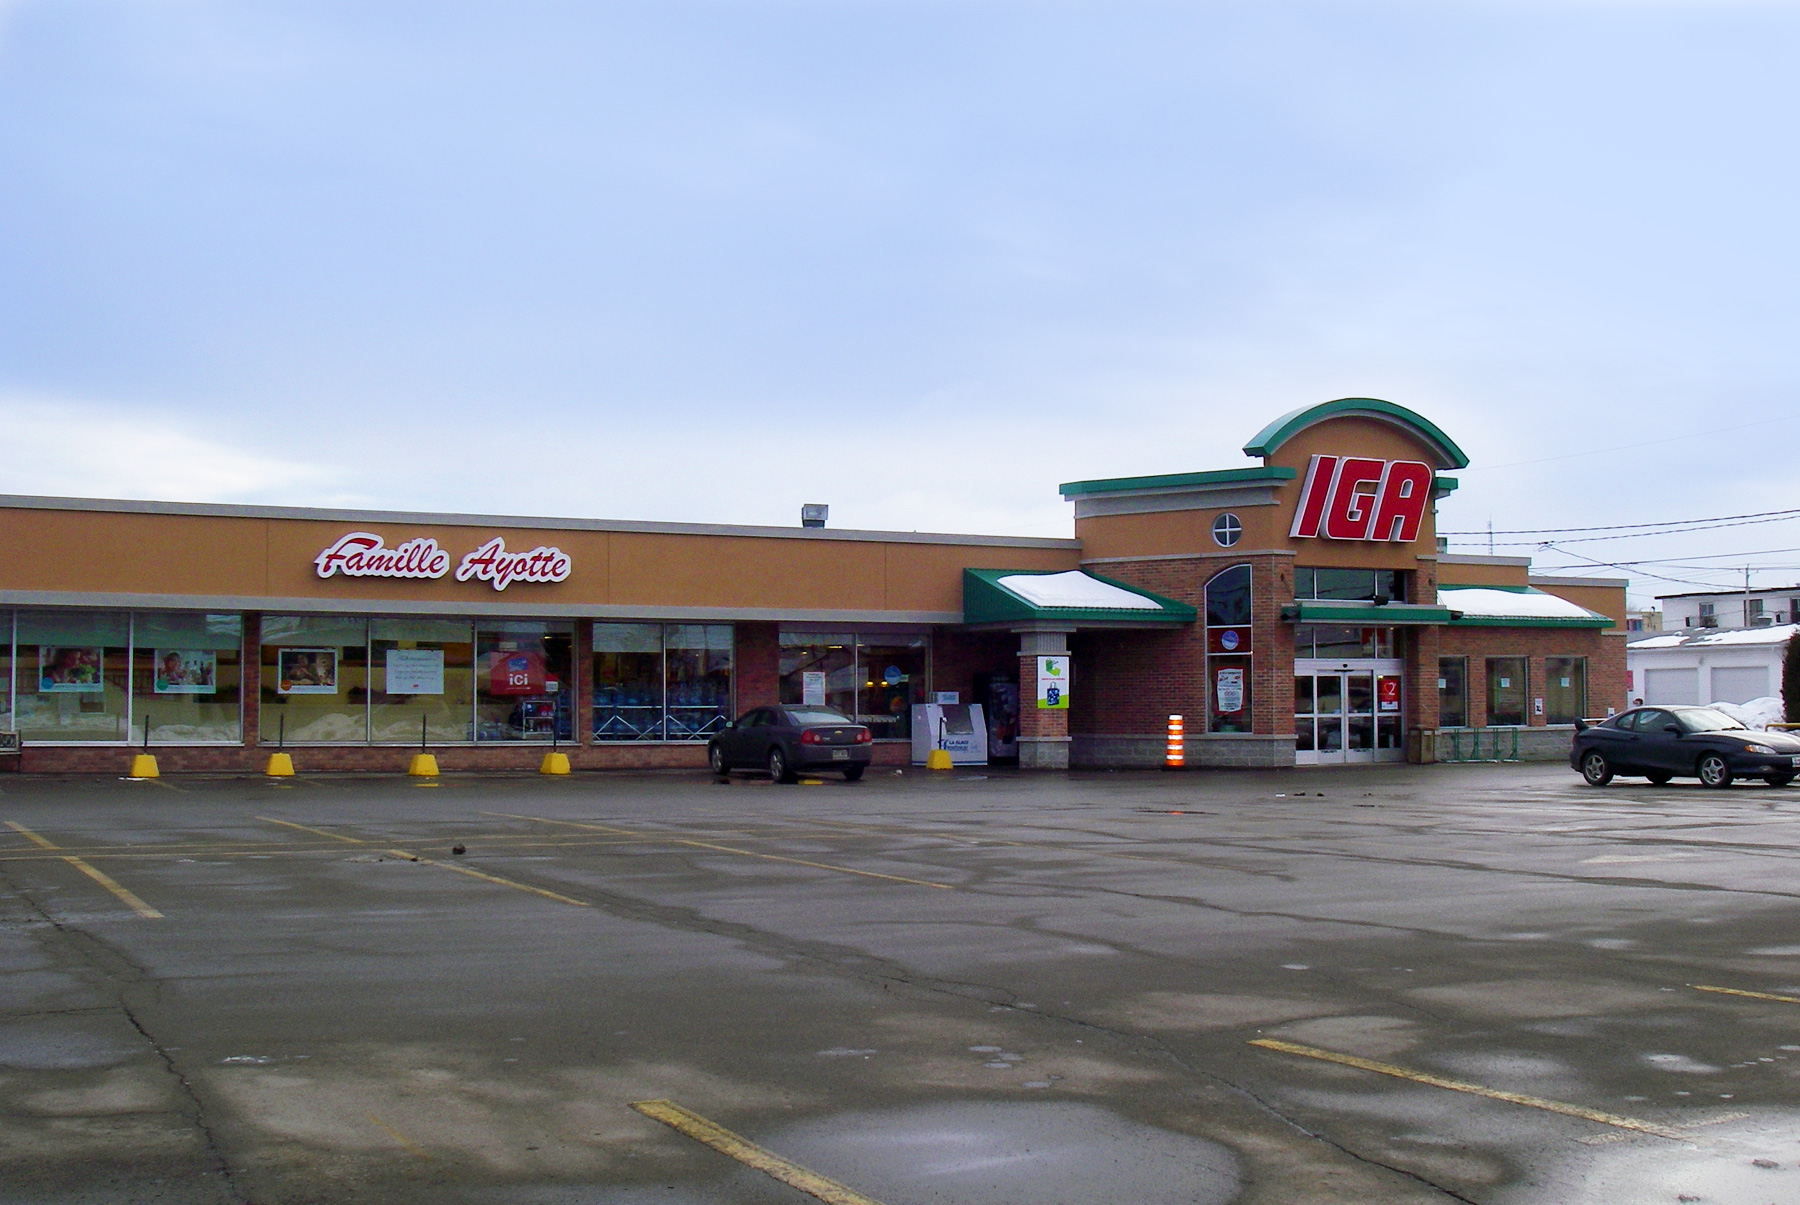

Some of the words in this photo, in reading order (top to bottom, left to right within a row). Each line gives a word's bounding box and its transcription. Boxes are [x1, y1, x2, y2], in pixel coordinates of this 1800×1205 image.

[1290, 454, 1432, 542] IGA
[320, 535, 447, 576] Famille
[459, 541, 568, 588] Ayotte
